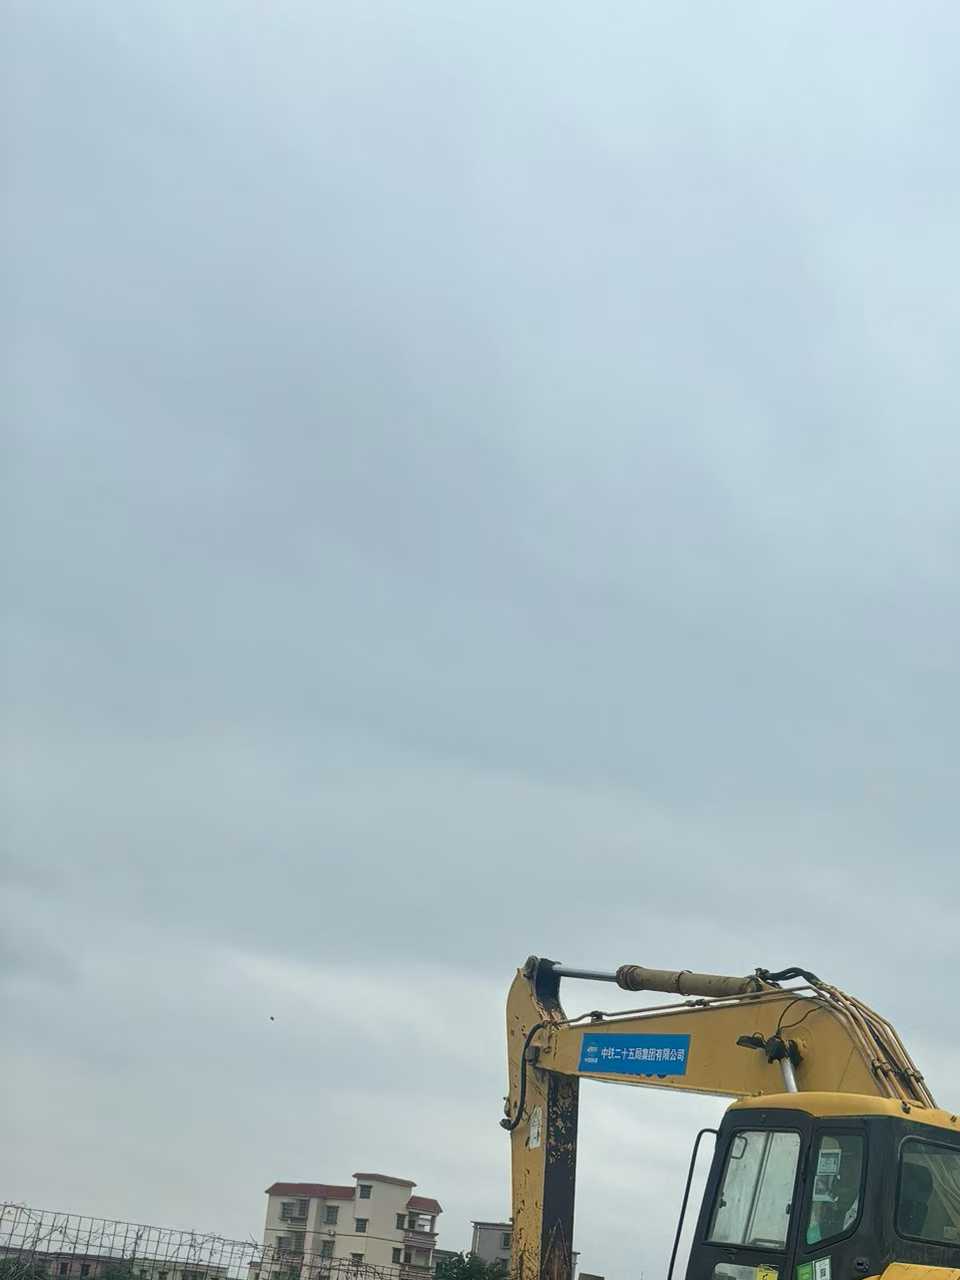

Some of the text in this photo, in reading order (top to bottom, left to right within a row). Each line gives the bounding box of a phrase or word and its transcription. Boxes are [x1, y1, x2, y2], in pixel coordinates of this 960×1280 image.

[601, 1047, 685, 1062] 中铁二十五局集团有限公司
